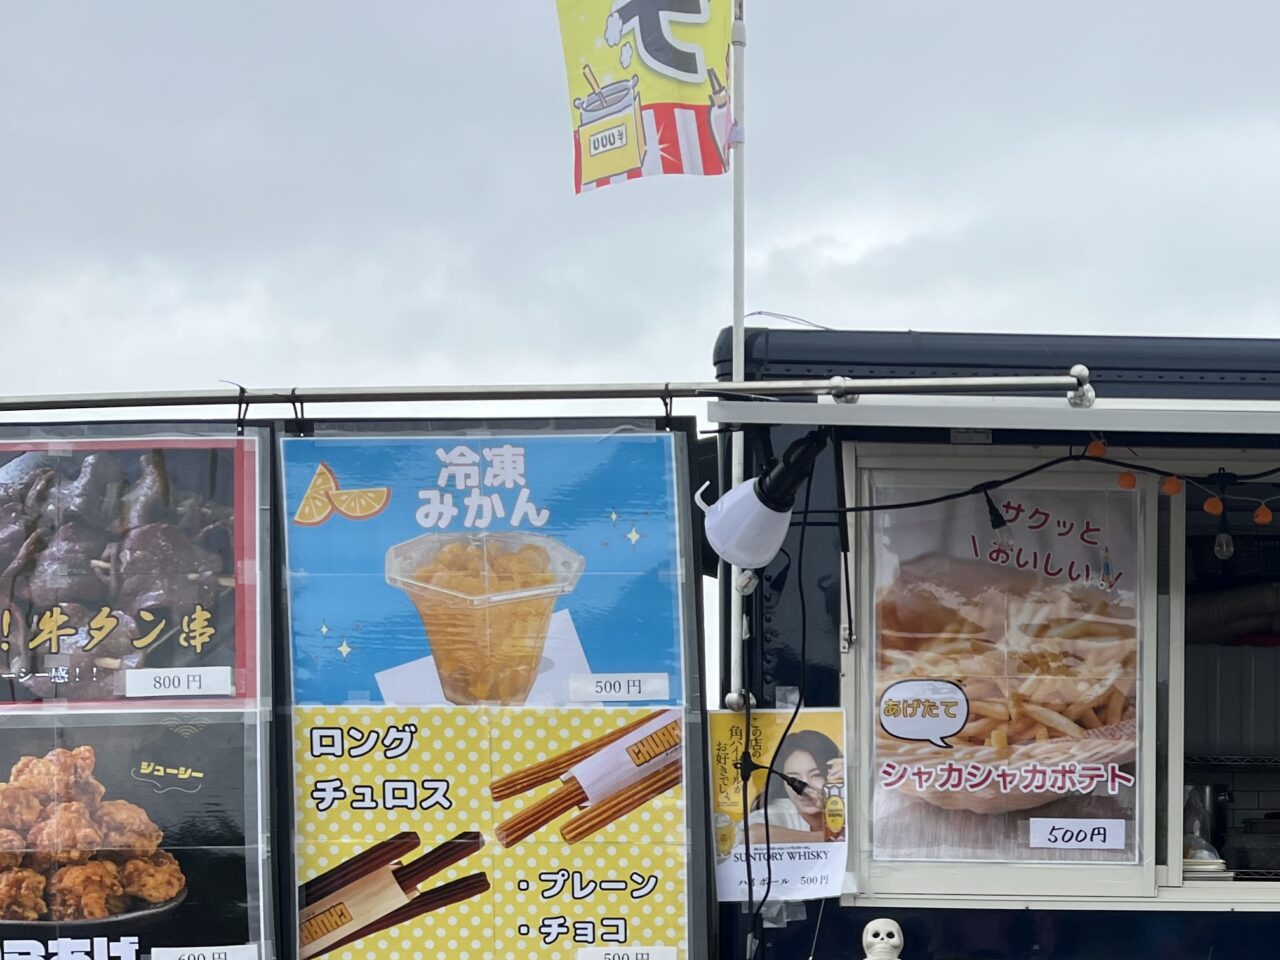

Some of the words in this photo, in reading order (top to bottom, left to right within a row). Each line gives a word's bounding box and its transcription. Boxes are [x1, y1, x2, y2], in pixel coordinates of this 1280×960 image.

[437, 445, 526, 487] 冷凍
[416, 488, 549, 529] みかん
[1002, 501, 1101, 547] サクッと
[883, 698, 958, 719] あげたて
[310, 723, 417, 758] ロング
[139, 760, 204, 781] ジューシー
[880, 761, 1135, 794] シャカシャカポテト
[310, 780, 453, 811] チュロス
[1048, 826, 1107, 844] 500円
[788, 850, 830, 862] WHISKY
